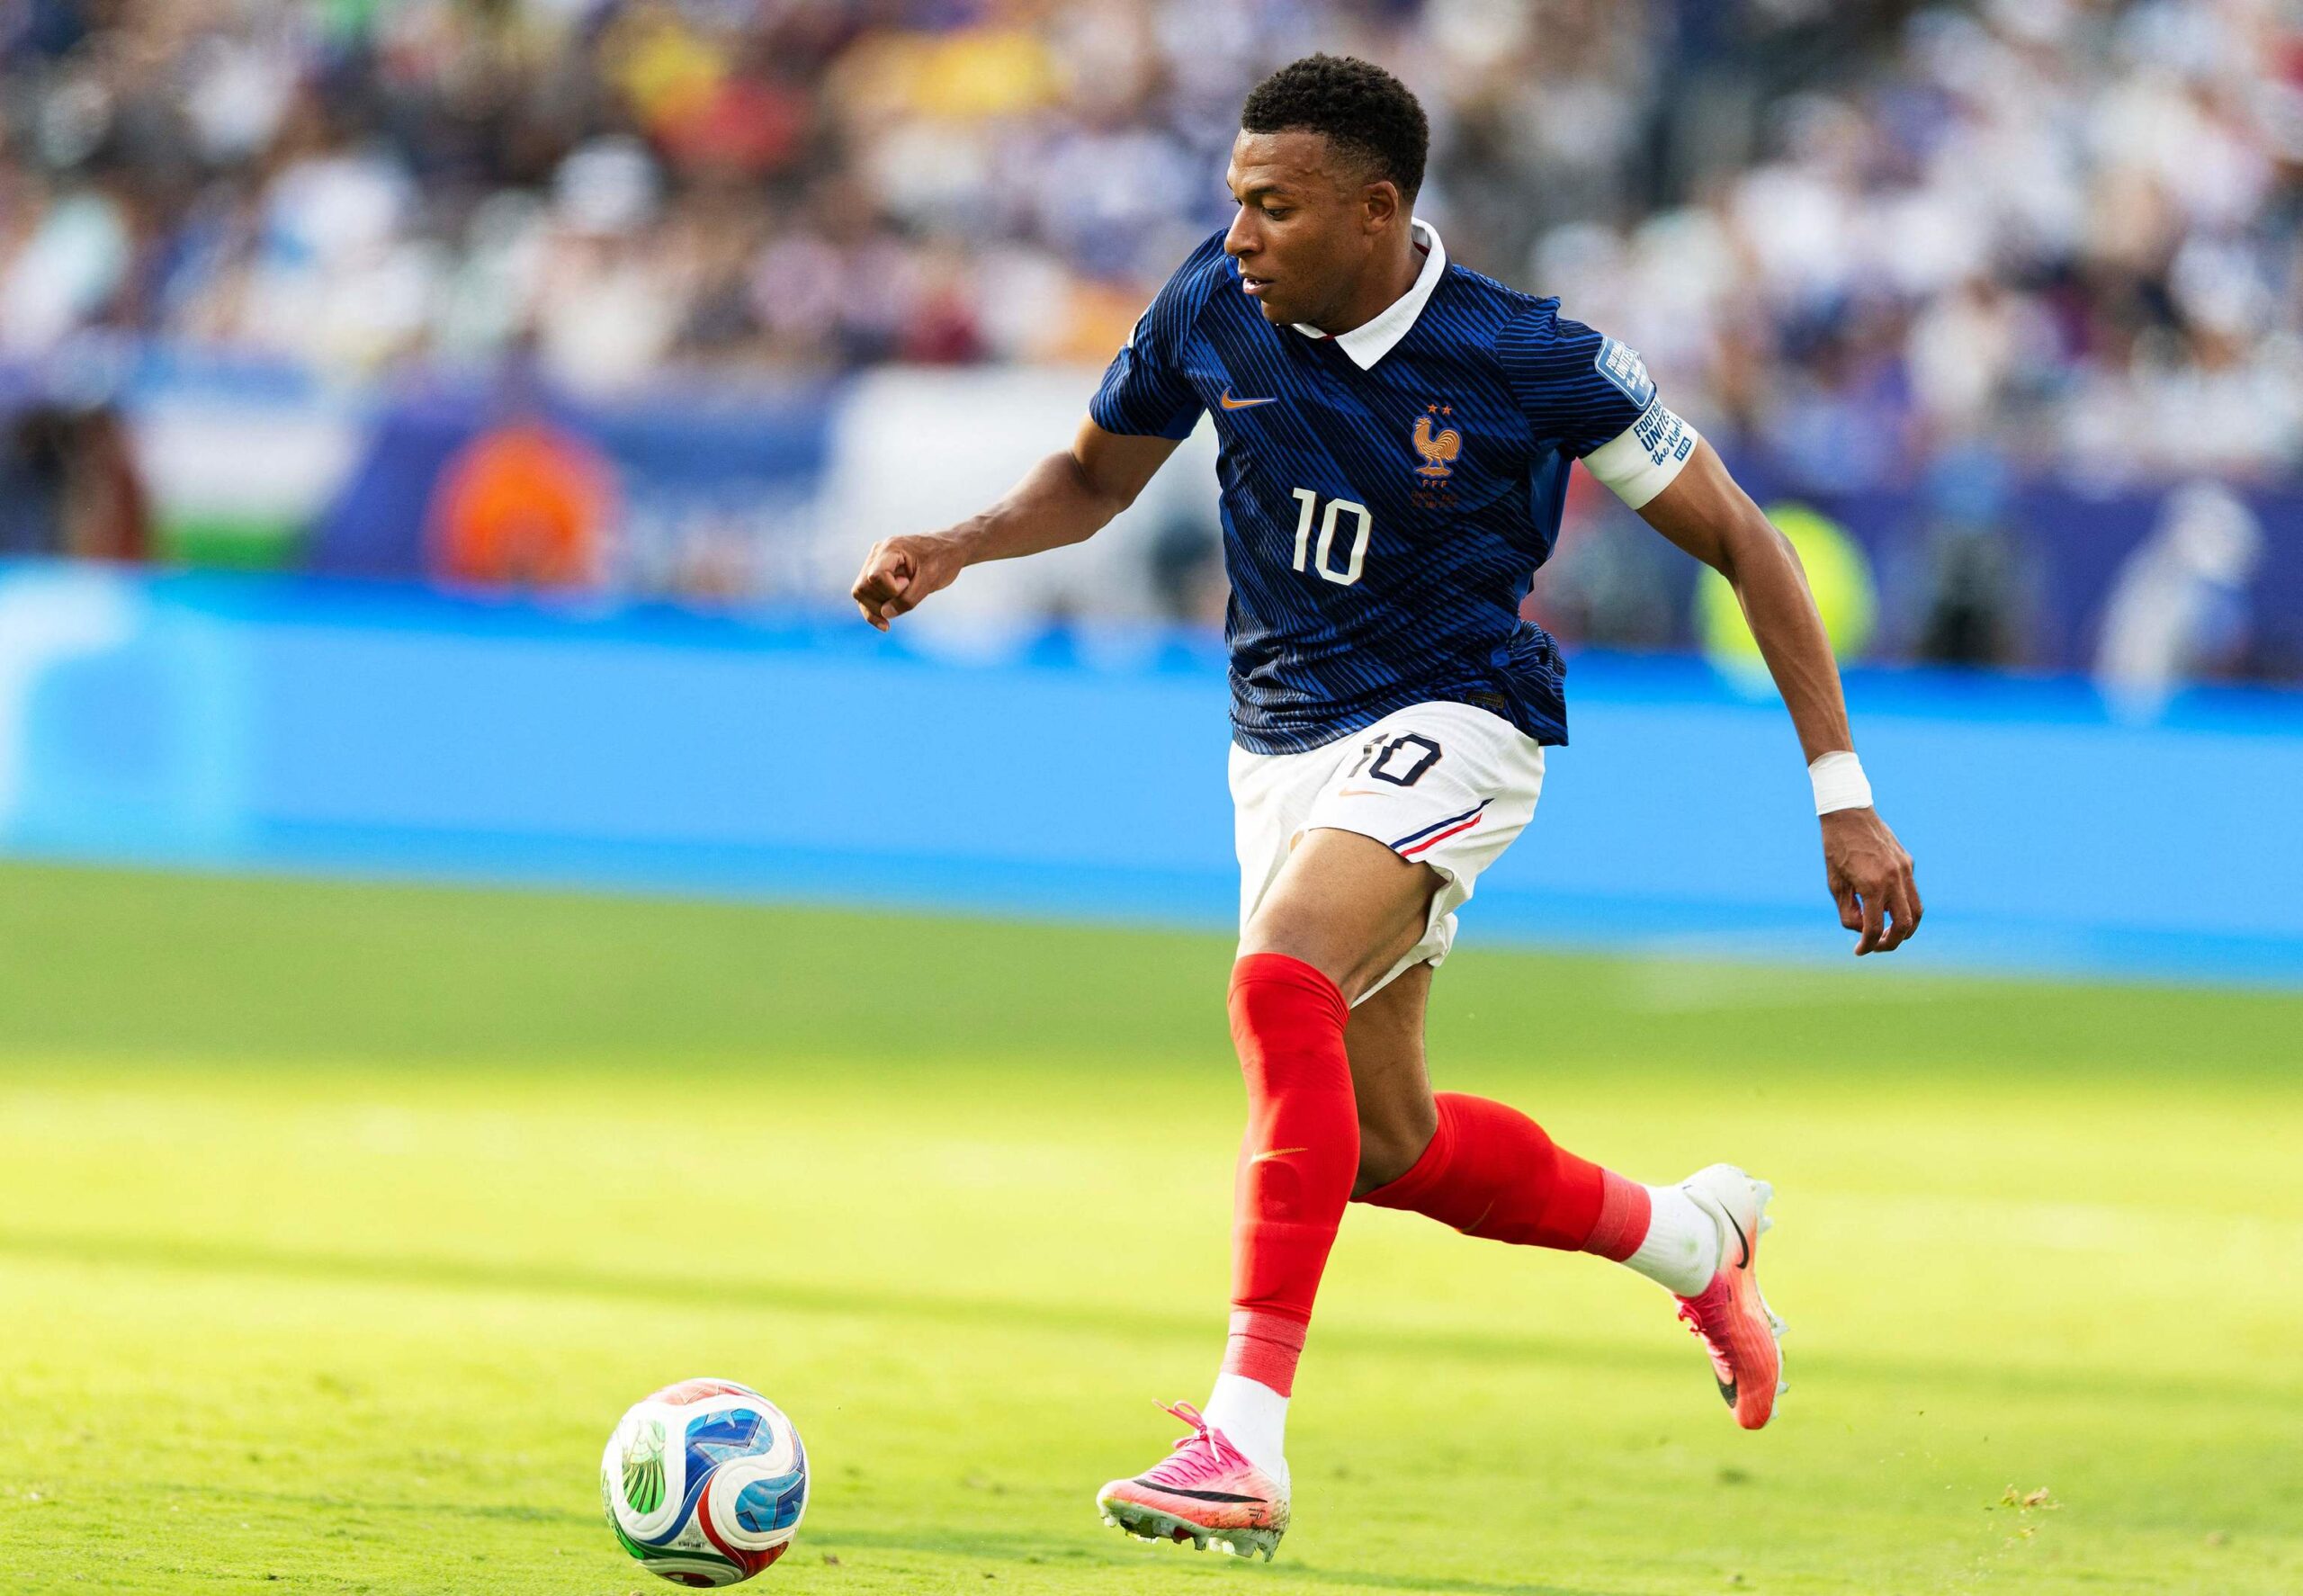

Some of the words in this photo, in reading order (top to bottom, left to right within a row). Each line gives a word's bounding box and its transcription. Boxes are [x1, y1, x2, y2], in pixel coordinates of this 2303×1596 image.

[1634, 399, 1662, 438] FOOTBA
[1651, 447, 1670, 466] the
[1674, 438, 1691, 461] FIFA
[1293, 487, 1374, 587] 10
[1348, 733, 1443, 787] 10
